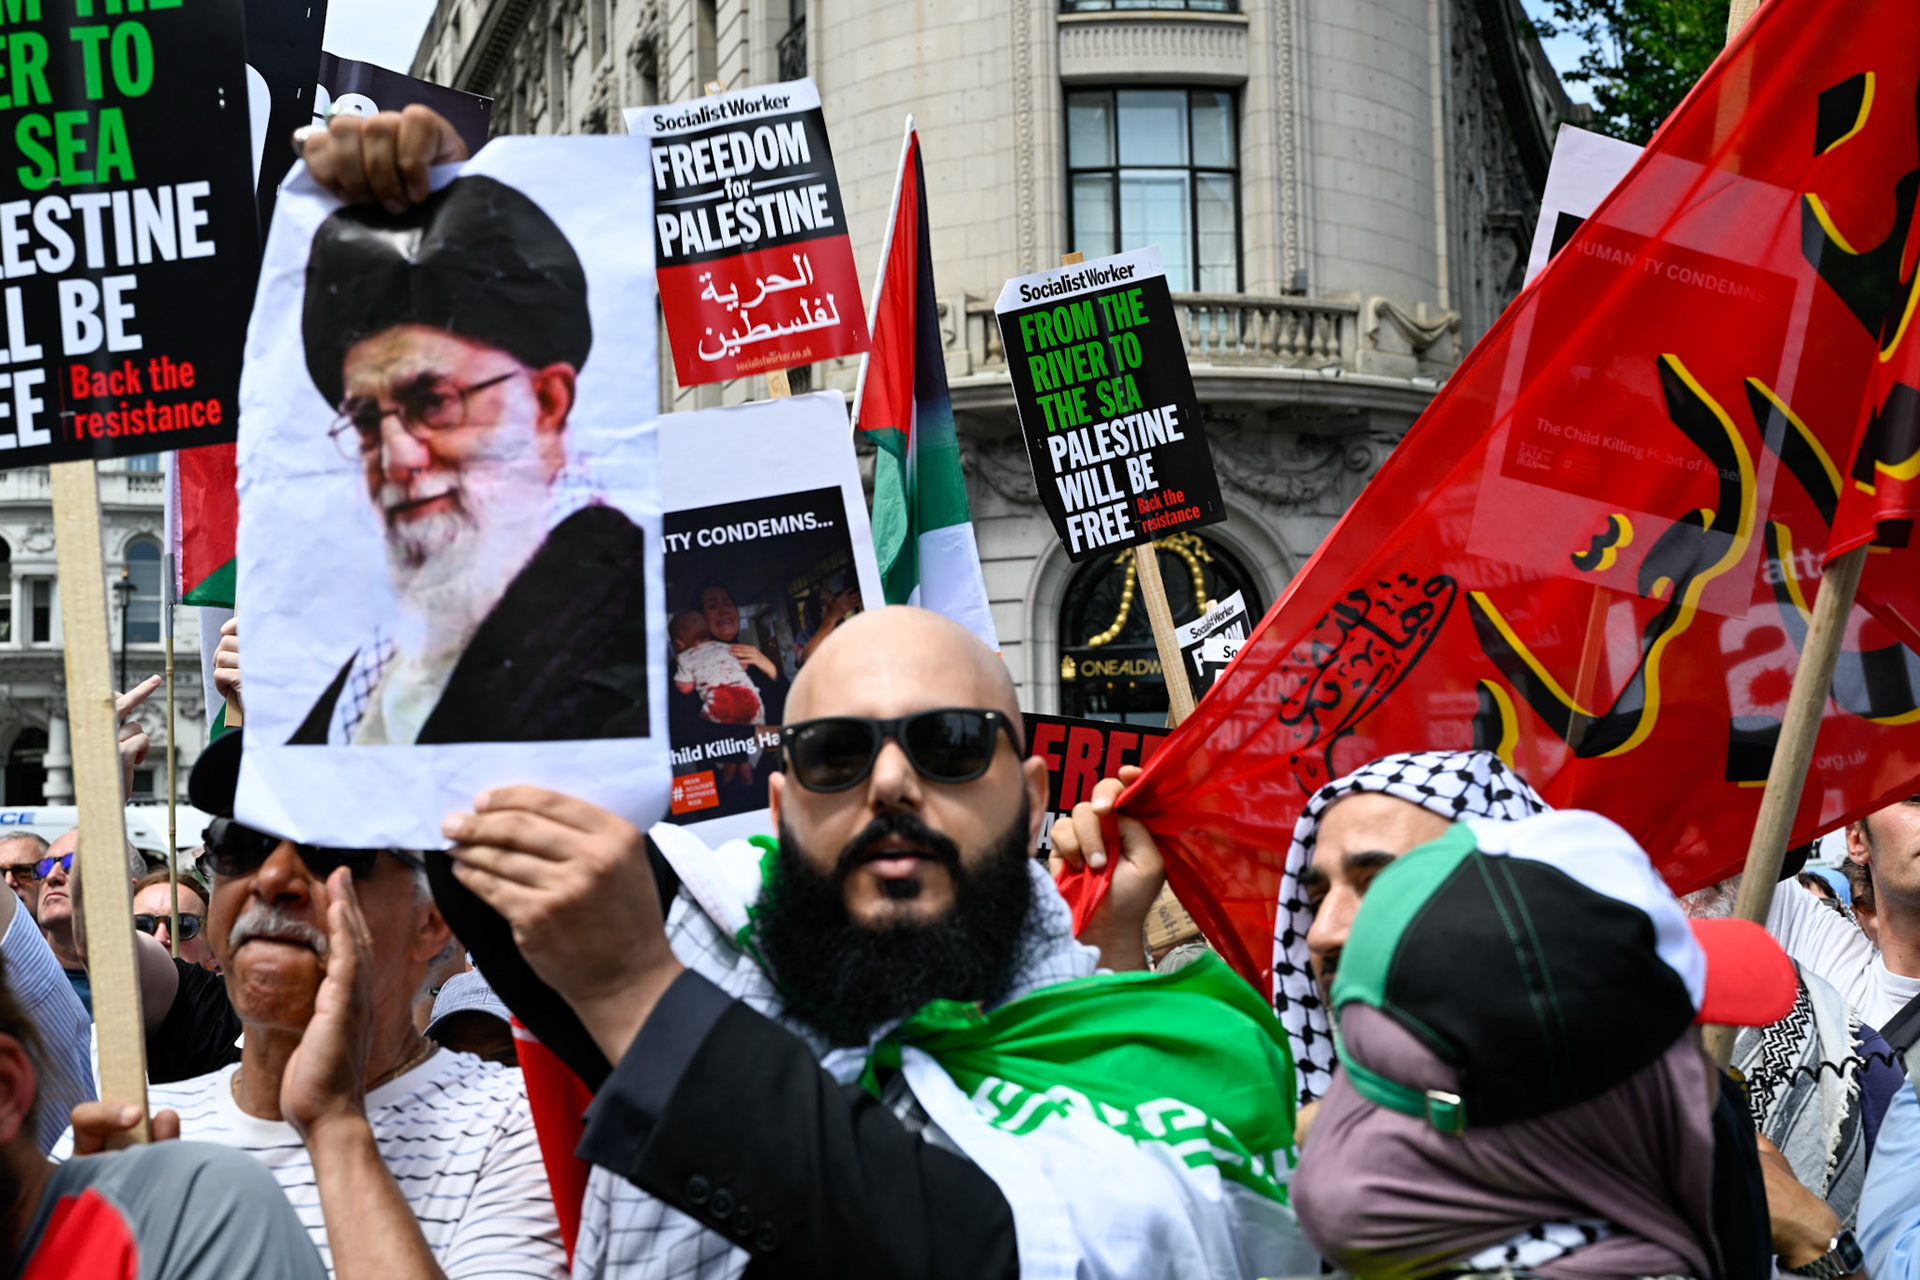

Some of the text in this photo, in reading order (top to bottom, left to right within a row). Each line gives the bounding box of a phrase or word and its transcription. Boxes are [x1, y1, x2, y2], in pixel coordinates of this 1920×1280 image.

[69, 20, 154, 100] TO
[15, 107, 136, 192] SEA
[651, 120, 811, 190] FREEDOM
[724, 177, 752, 200] for
[0, 181, 216, 280] ESTINE
[656, 183, 834, 258] PALESTINE
[699, 252, 814, 312] الحرية
[57, 273, 143, 357] BE
[698, 292, 841, 361] لفلسطين
[1019, 287, 1149, 352] FROM THE
[69, 355, 196, 400] Back the
[1028, 332, 1143, 394] RIVER TO
[73, 398, 223, 440] resistance
[1036, 374, 1143, 433] THE SEA
[1047, 404, 1185, 474] PALESTINE
[1537, 417, 1561, 436] The
[1564, 425, 1600, 446] Child
[1602, 435, 1644, 460] Killing
[1055, 454, 1160, 513] WILL BE
[1137, 488, 1185, 515] Back the
[1066, 503, 1135, 554] FREE
[1141, 504, 1201, 533] resistance
[704, 736, 758, 759] Killing
